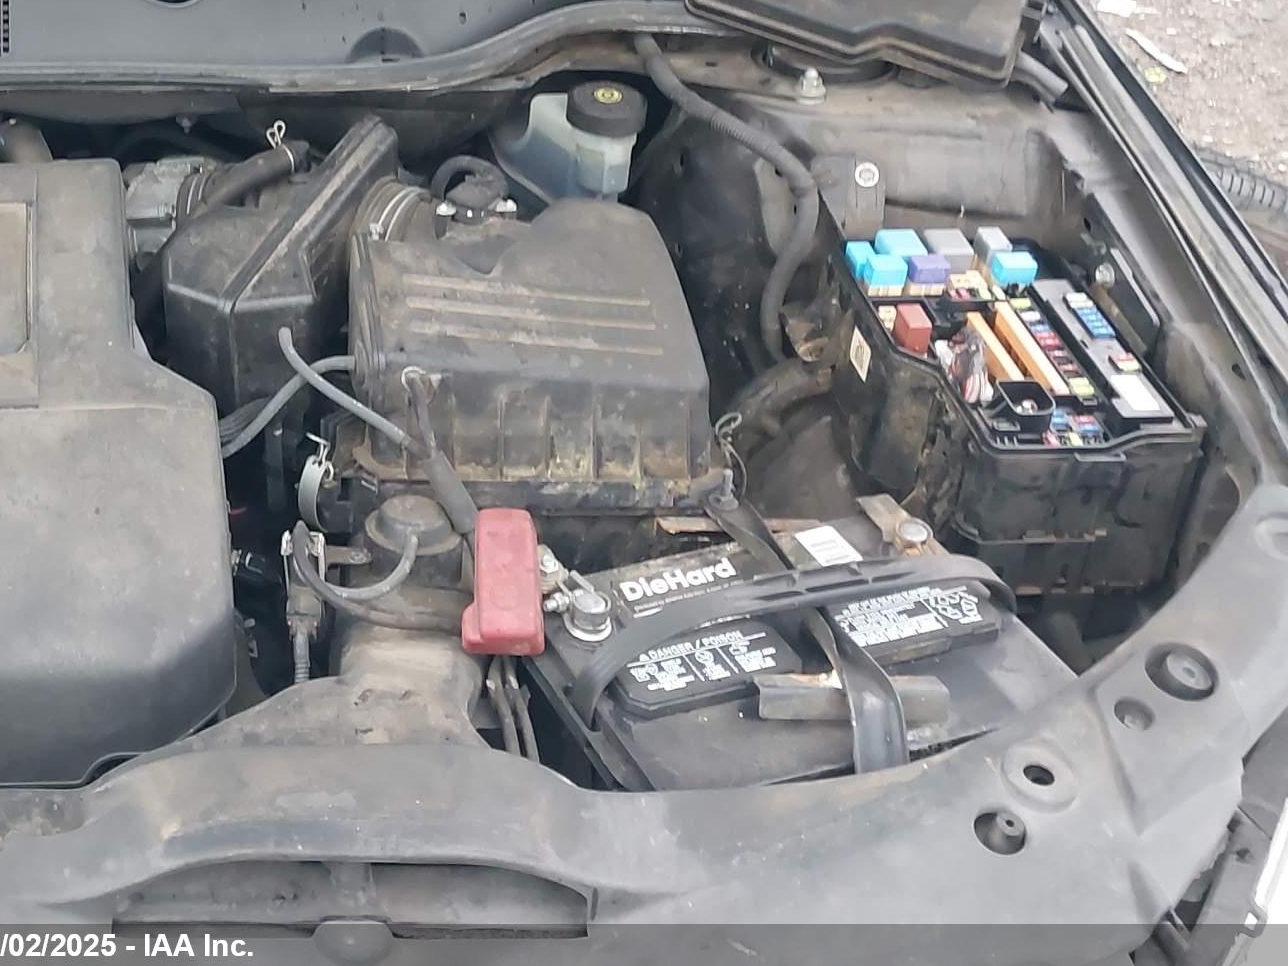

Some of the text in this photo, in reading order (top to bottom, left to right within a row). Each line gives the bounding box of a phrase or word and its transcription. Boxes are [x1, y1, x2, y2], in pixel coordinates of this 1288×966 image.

[619, 557, 737, 602] DieHard
[647, 641, 694, 659] DANGER
[702, 630, 745, 647] POISON
